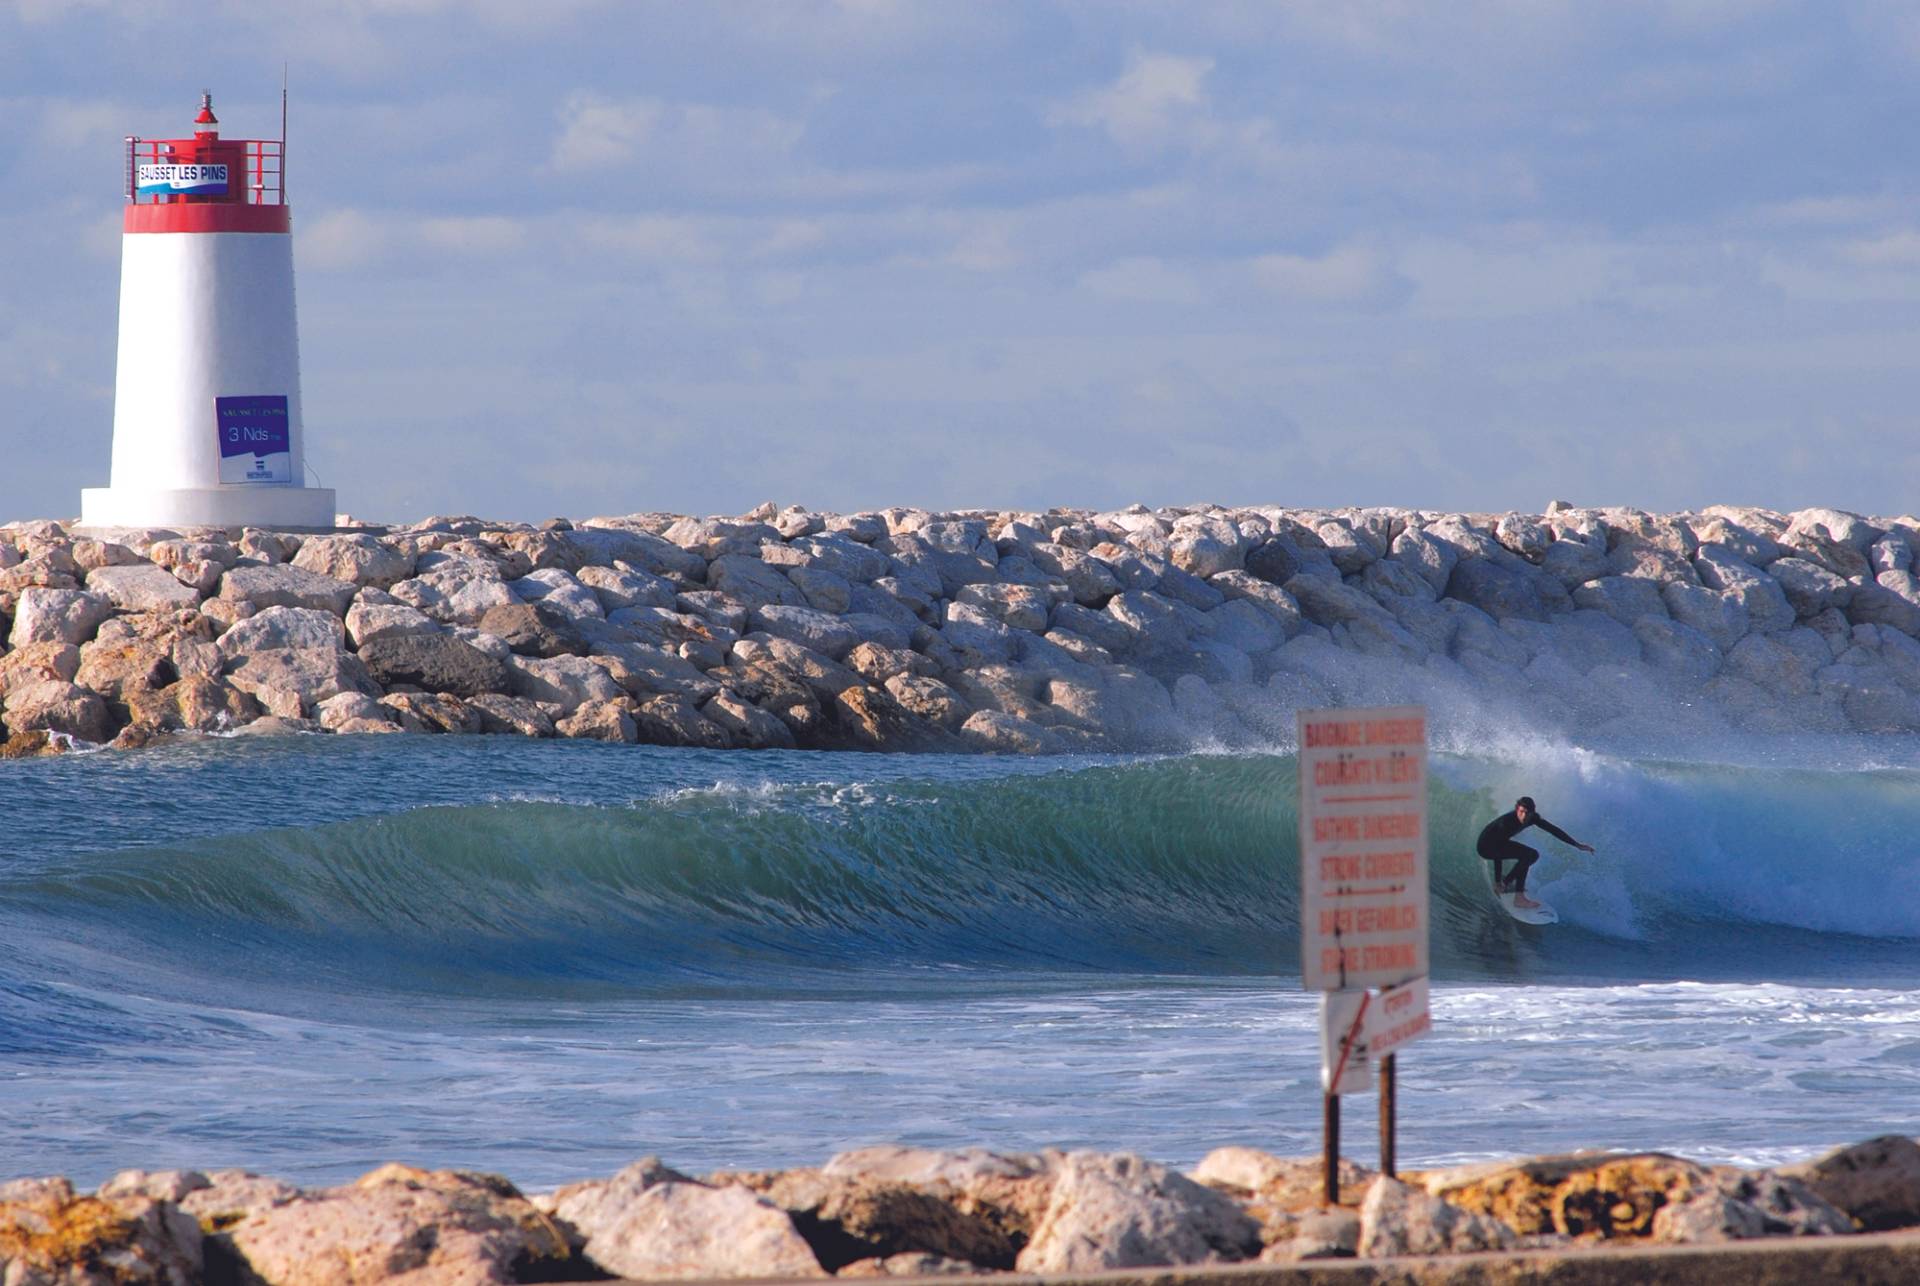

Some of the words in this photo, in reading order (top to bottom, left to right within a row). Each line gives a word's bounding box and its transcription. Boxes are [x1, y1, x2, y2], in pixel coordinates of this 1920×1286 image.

[141, 167, 176, 180] SAUSSET
[179, 166, 198, 180] LES
[201, 165, 227, 180] PINS
[229, 427, 239, 442] 3
[244, 426, 269, 441] Nds
